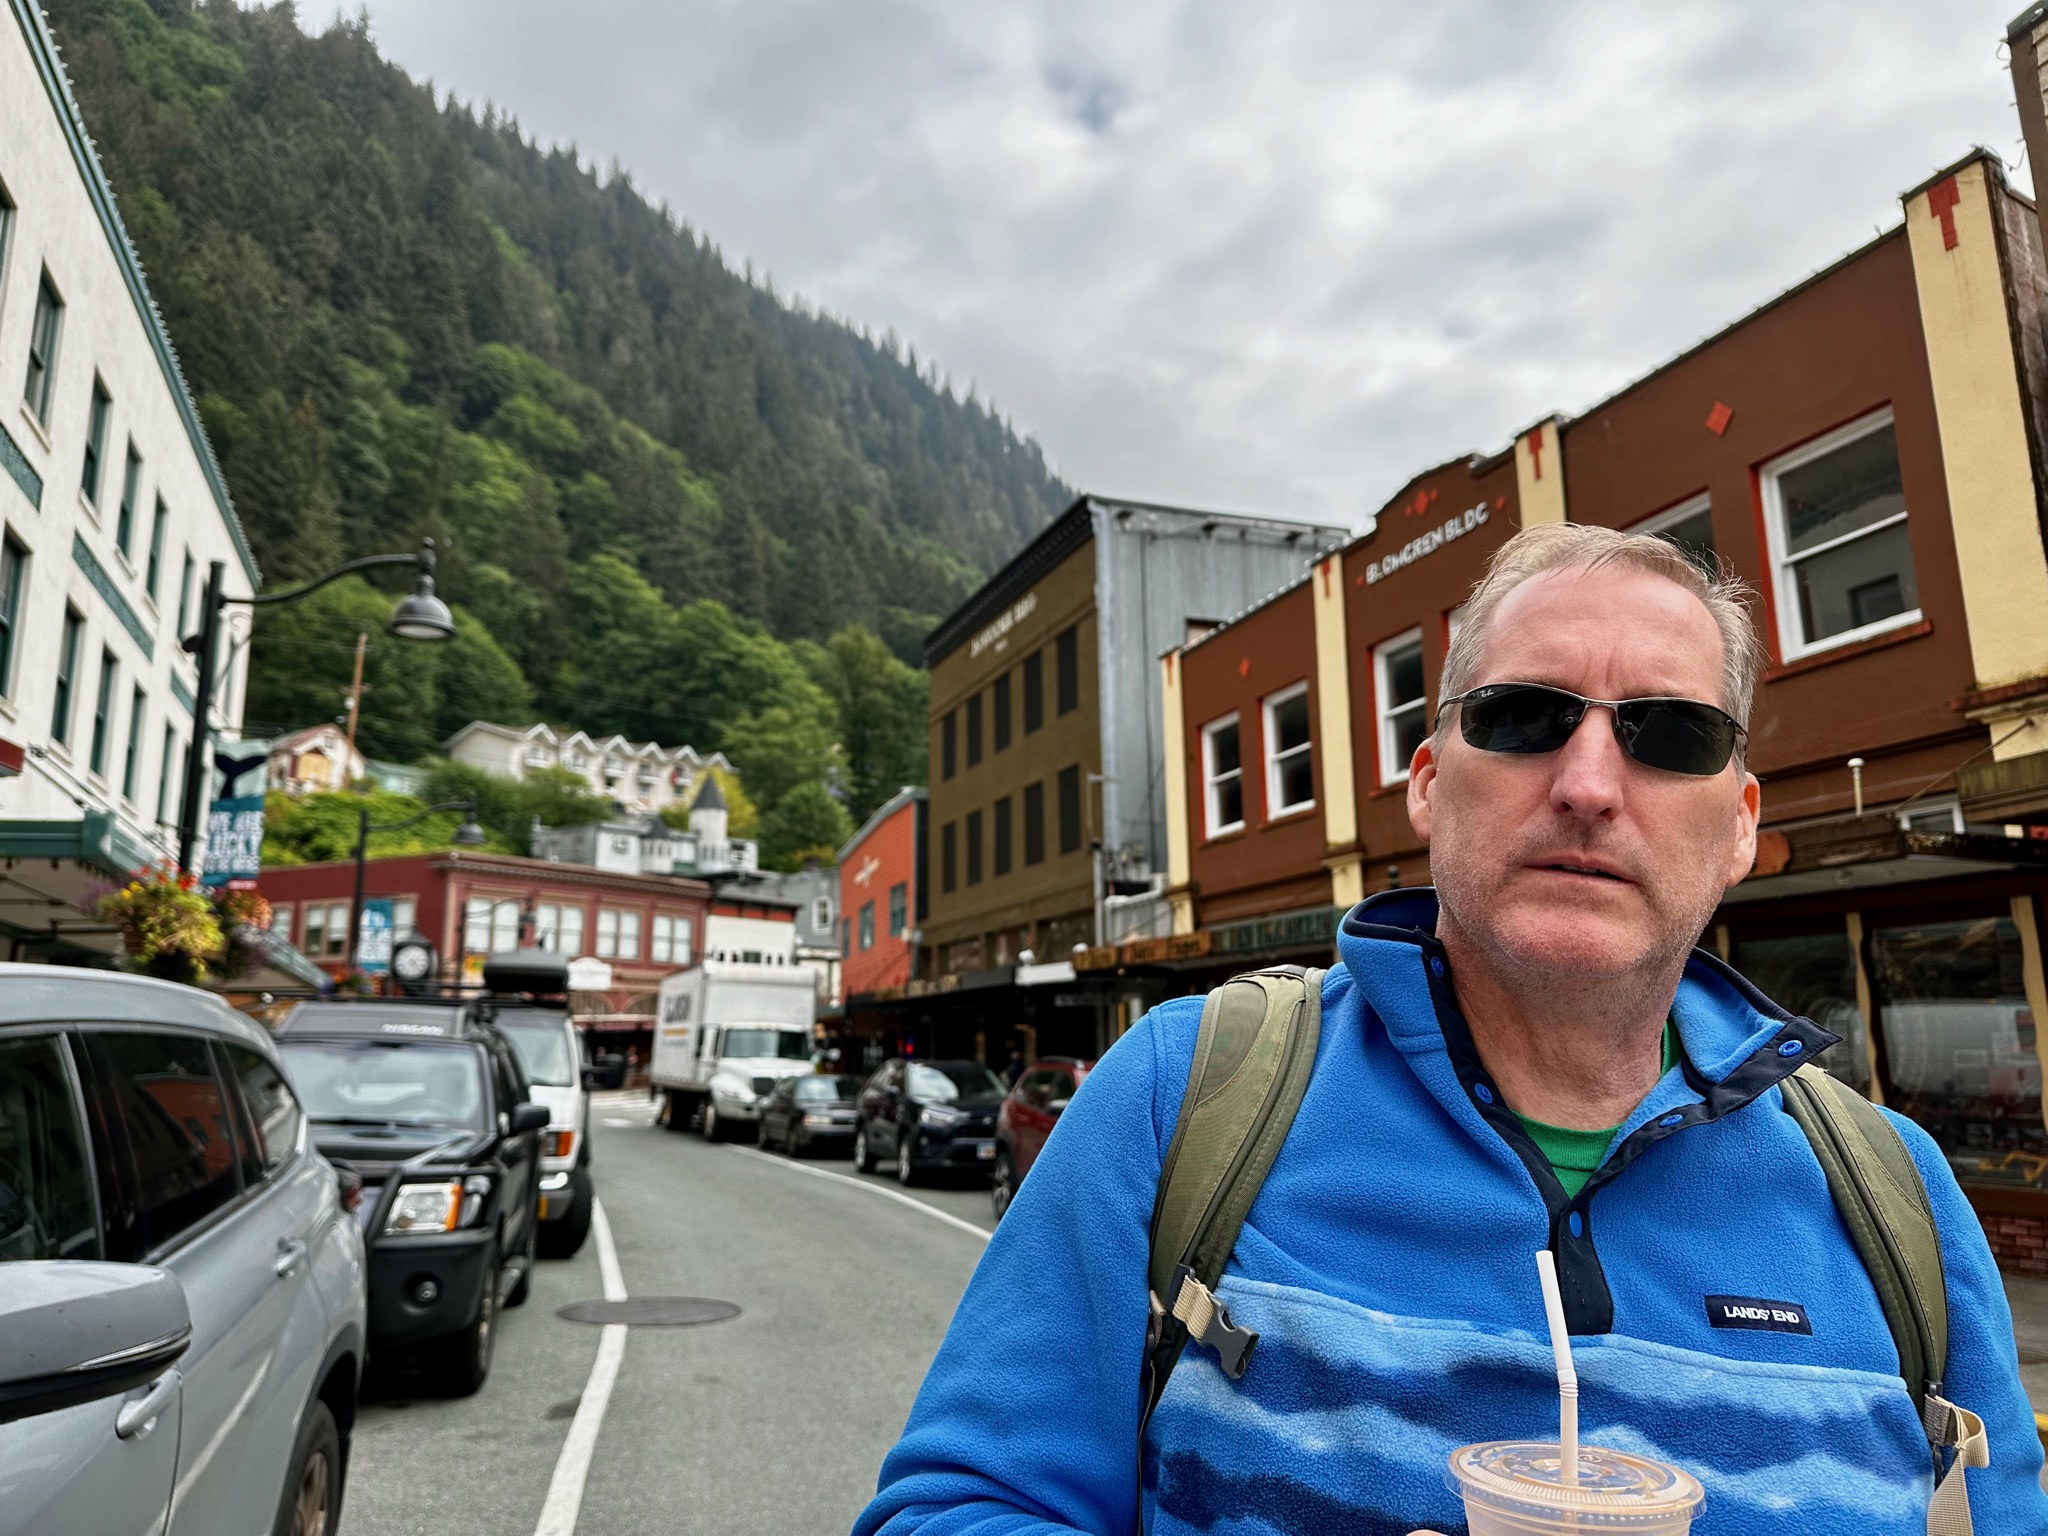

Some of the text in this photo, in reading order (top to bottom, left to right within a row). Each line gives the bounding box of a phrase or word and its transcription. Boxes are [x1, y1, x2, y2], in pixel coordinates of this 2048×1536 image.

[206, 831, 264, 856] LUCKY
[1723, 1305, 1800, 1324] LANDS' END
